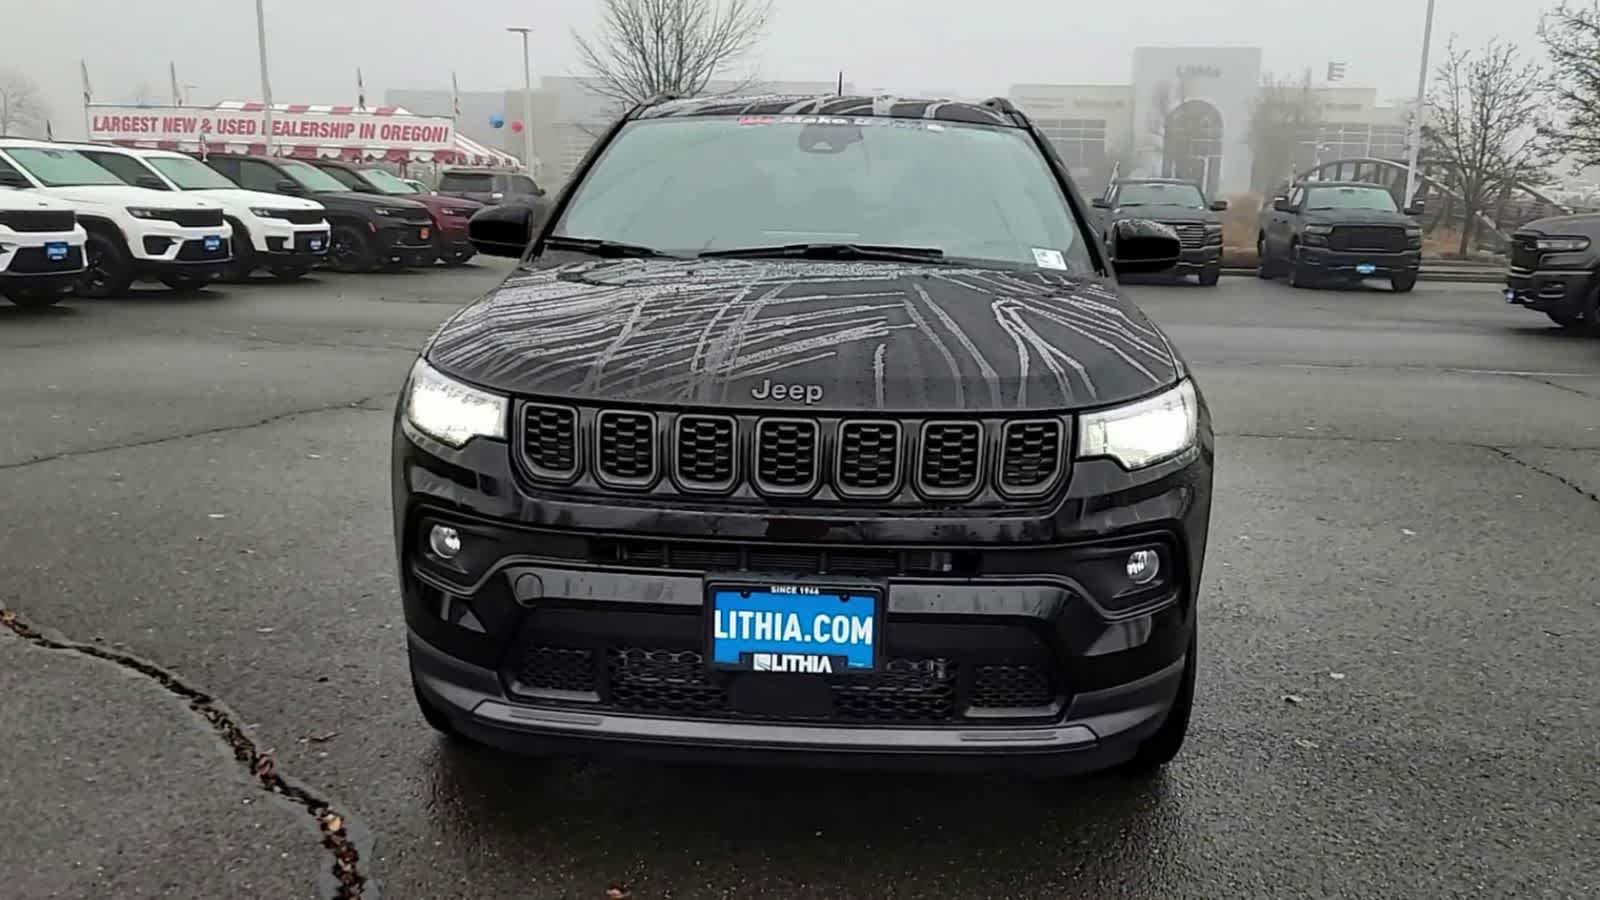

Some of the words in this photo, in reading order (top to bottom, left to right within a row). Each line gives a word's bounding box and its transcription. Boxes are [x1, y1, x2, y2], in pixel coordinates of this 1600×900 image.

[93, 115, 159, 133] LARGEST
[162, 117, 198, 134] NEW
[200, 118, 213, 135] &
[216, 118, 257, 136] USED
[359, 122, 376, 140] IN
[380, 123, 449, 143] OREGON!
[751, 379, 824, 404] Jeep
[770, 585, 797, 595] SINCE
[713, 609, 874, 646] LITHIA.COM
[771, 653, 833, 674] LITHIA
